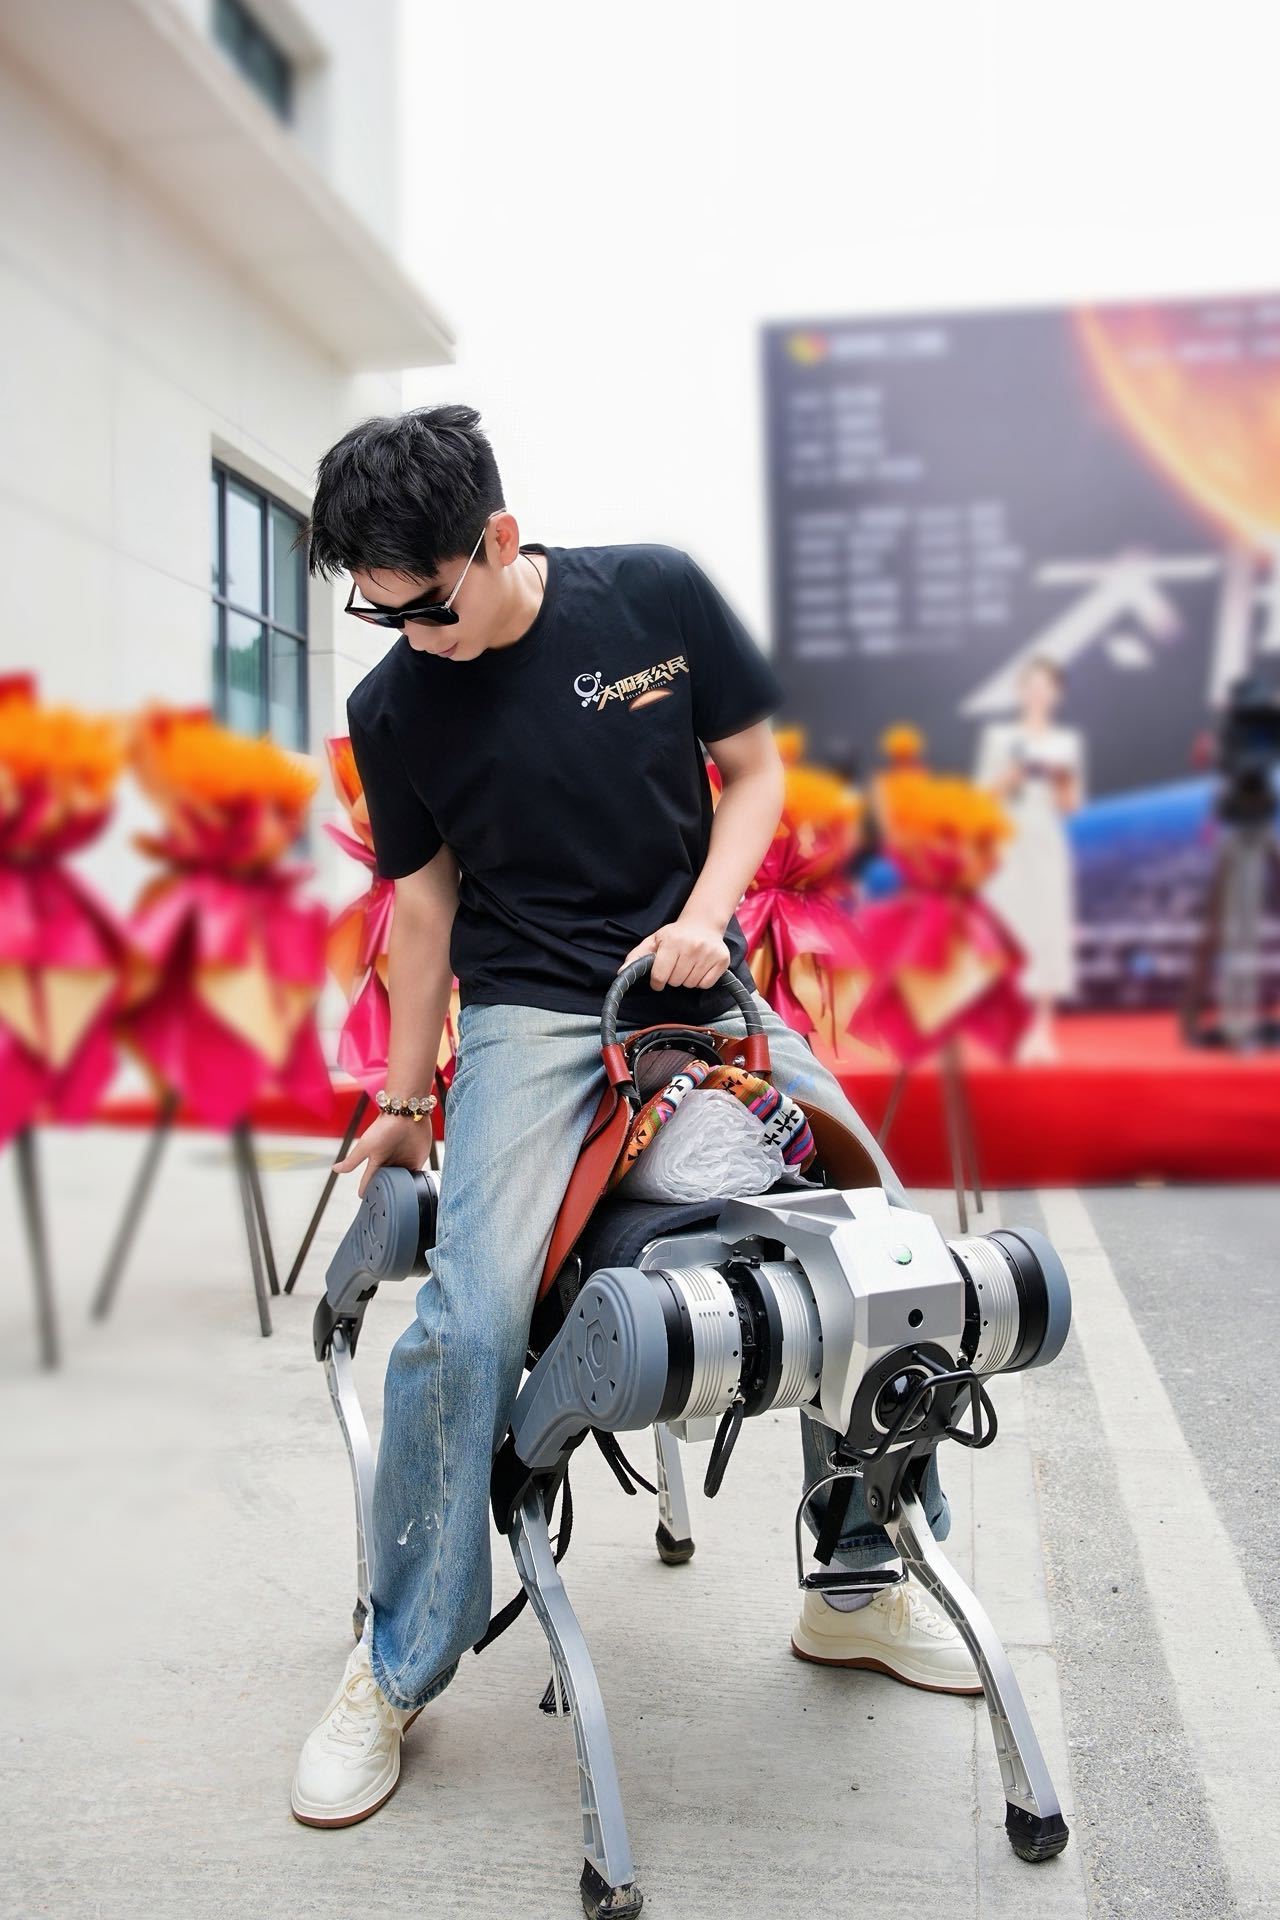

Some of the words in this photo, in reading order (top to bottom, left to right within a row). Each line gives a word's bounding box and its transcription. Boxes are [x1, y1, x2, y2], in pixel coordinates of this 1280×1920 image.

[597, 655, 689, 711] 太阳系公民
